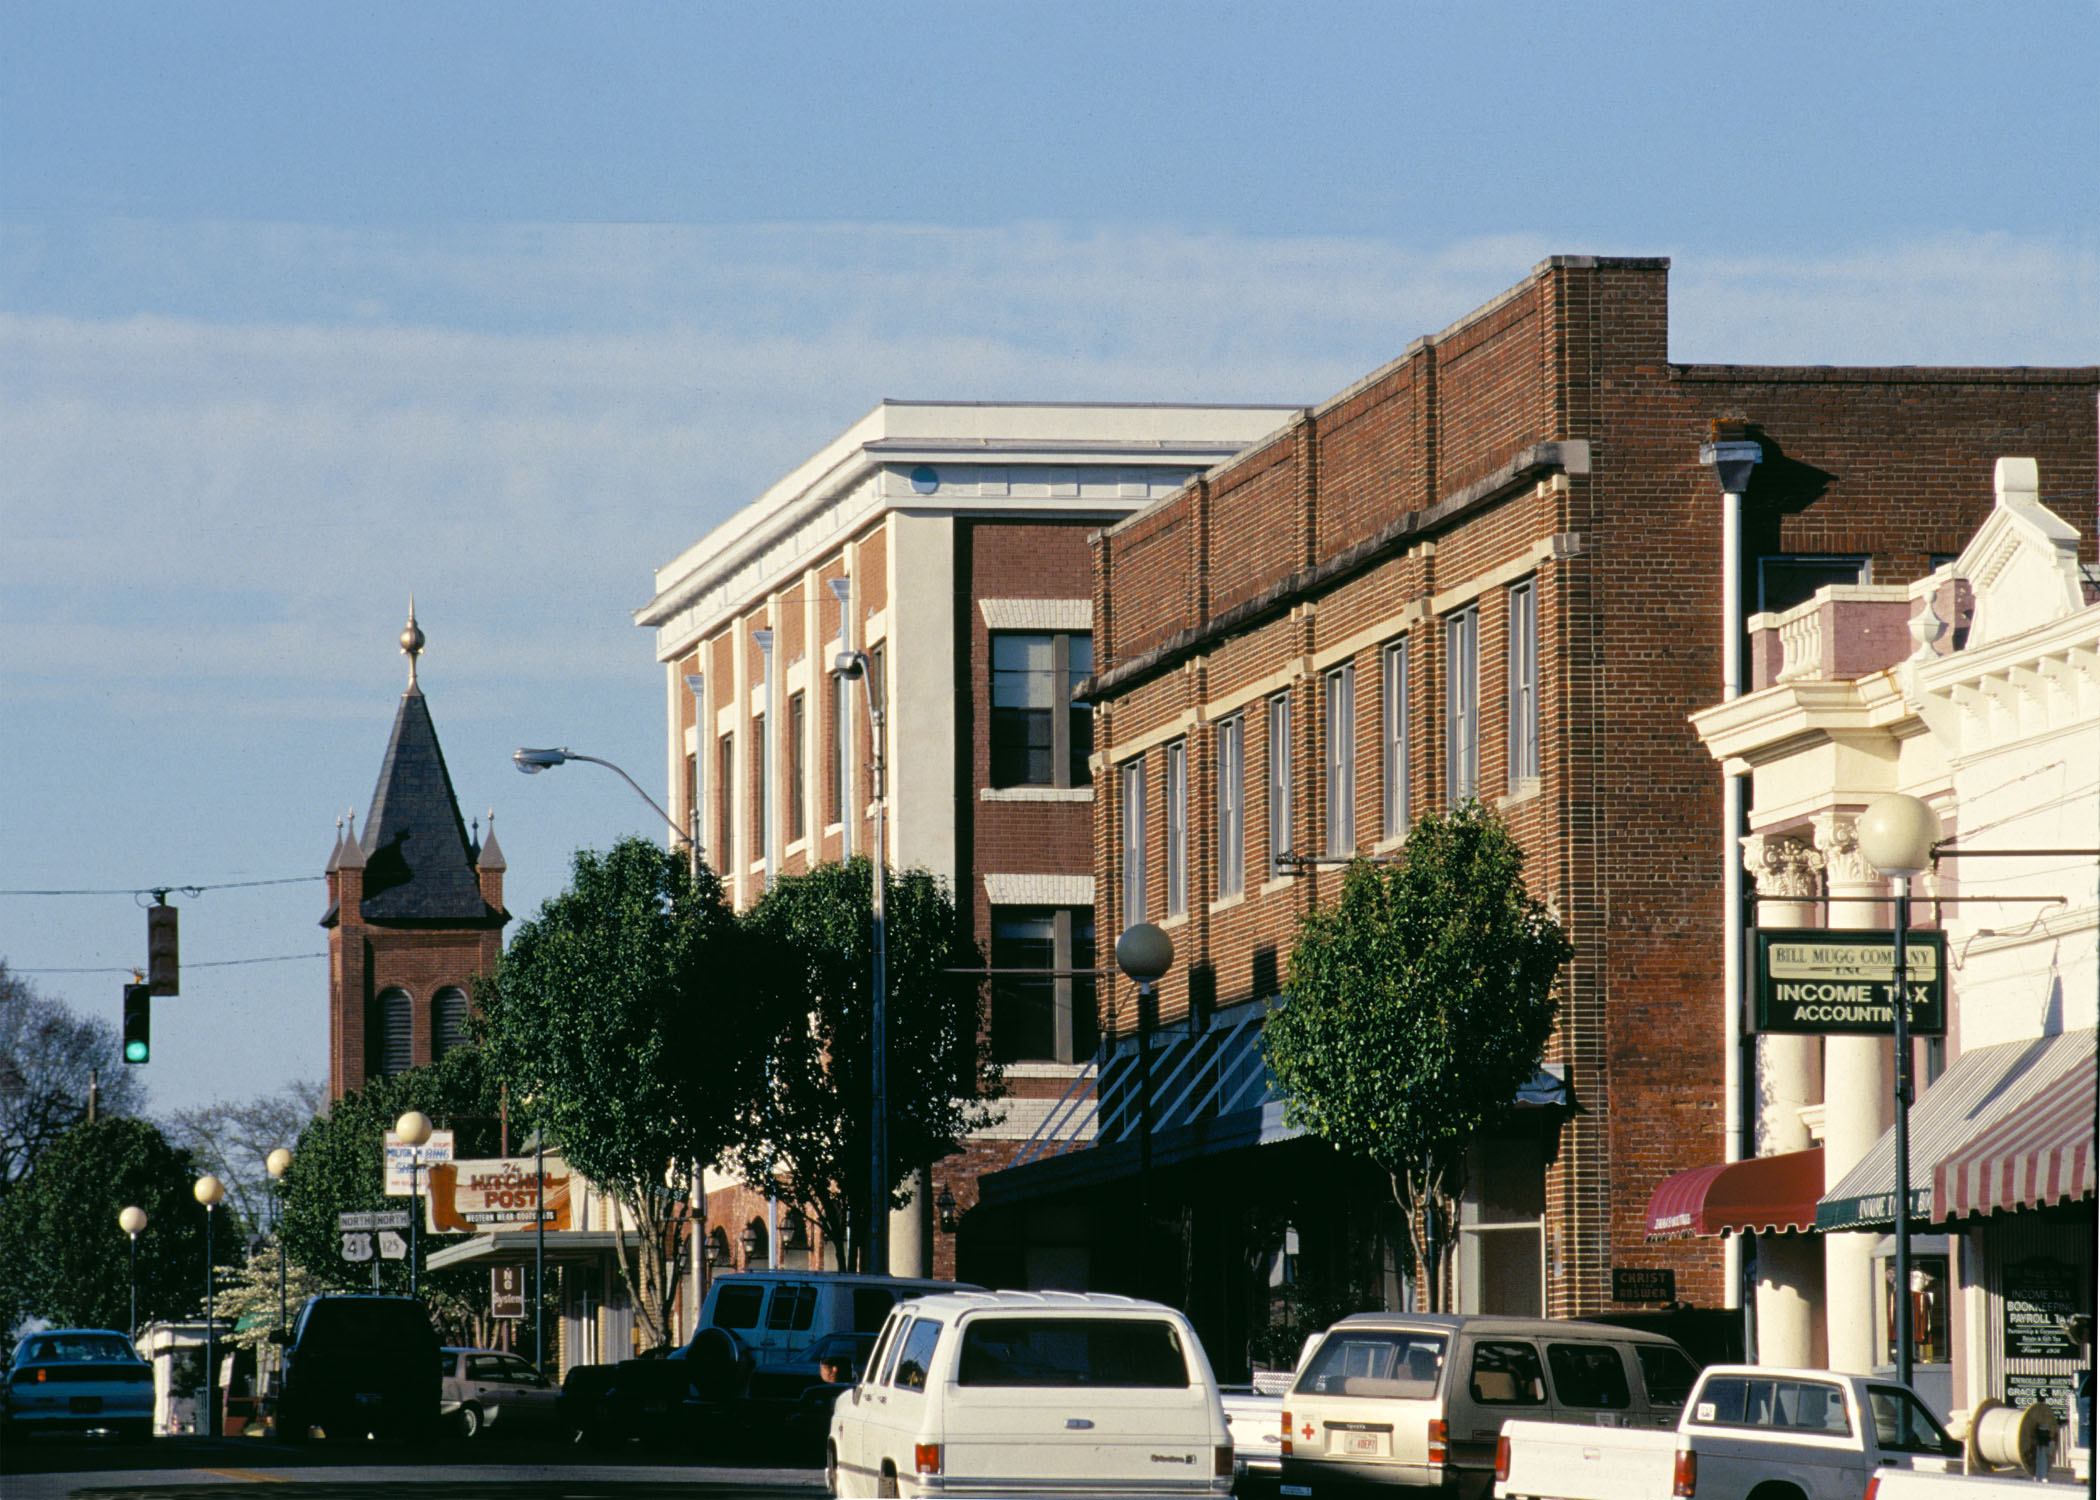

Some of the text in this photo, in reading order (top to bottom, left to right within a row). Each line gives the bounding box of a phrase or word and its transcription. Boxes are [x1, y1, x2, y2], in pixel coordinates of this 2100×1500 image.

[1776, 948, 1930, 965] BILL MUGG COMNY
[1776, 984, 1928, 1003] INCOME TX
[484, 1191, 538, 1209] POST
[342, 1216, 371, 1226] NORTH
[377, 1215, 407, 1225] NORTH
[347, 1240, 366, 1257] 41
[383, 1240, 399, 1253] 125
[1620, 1272, 1667, 1284] CHRIST
[1620, 1288, 1667, 1298] ANSWER
[2012, 1289, 2049, 1300] INCOME
[2006, 1301, 2075, 1313] BOOKKEEPING
[2009, 1313, 2070, 1324] PAYROLL TA
[2007, 1388, 2037, 1397] GRACE
[2039, 1388, 2049, 1397] C.
